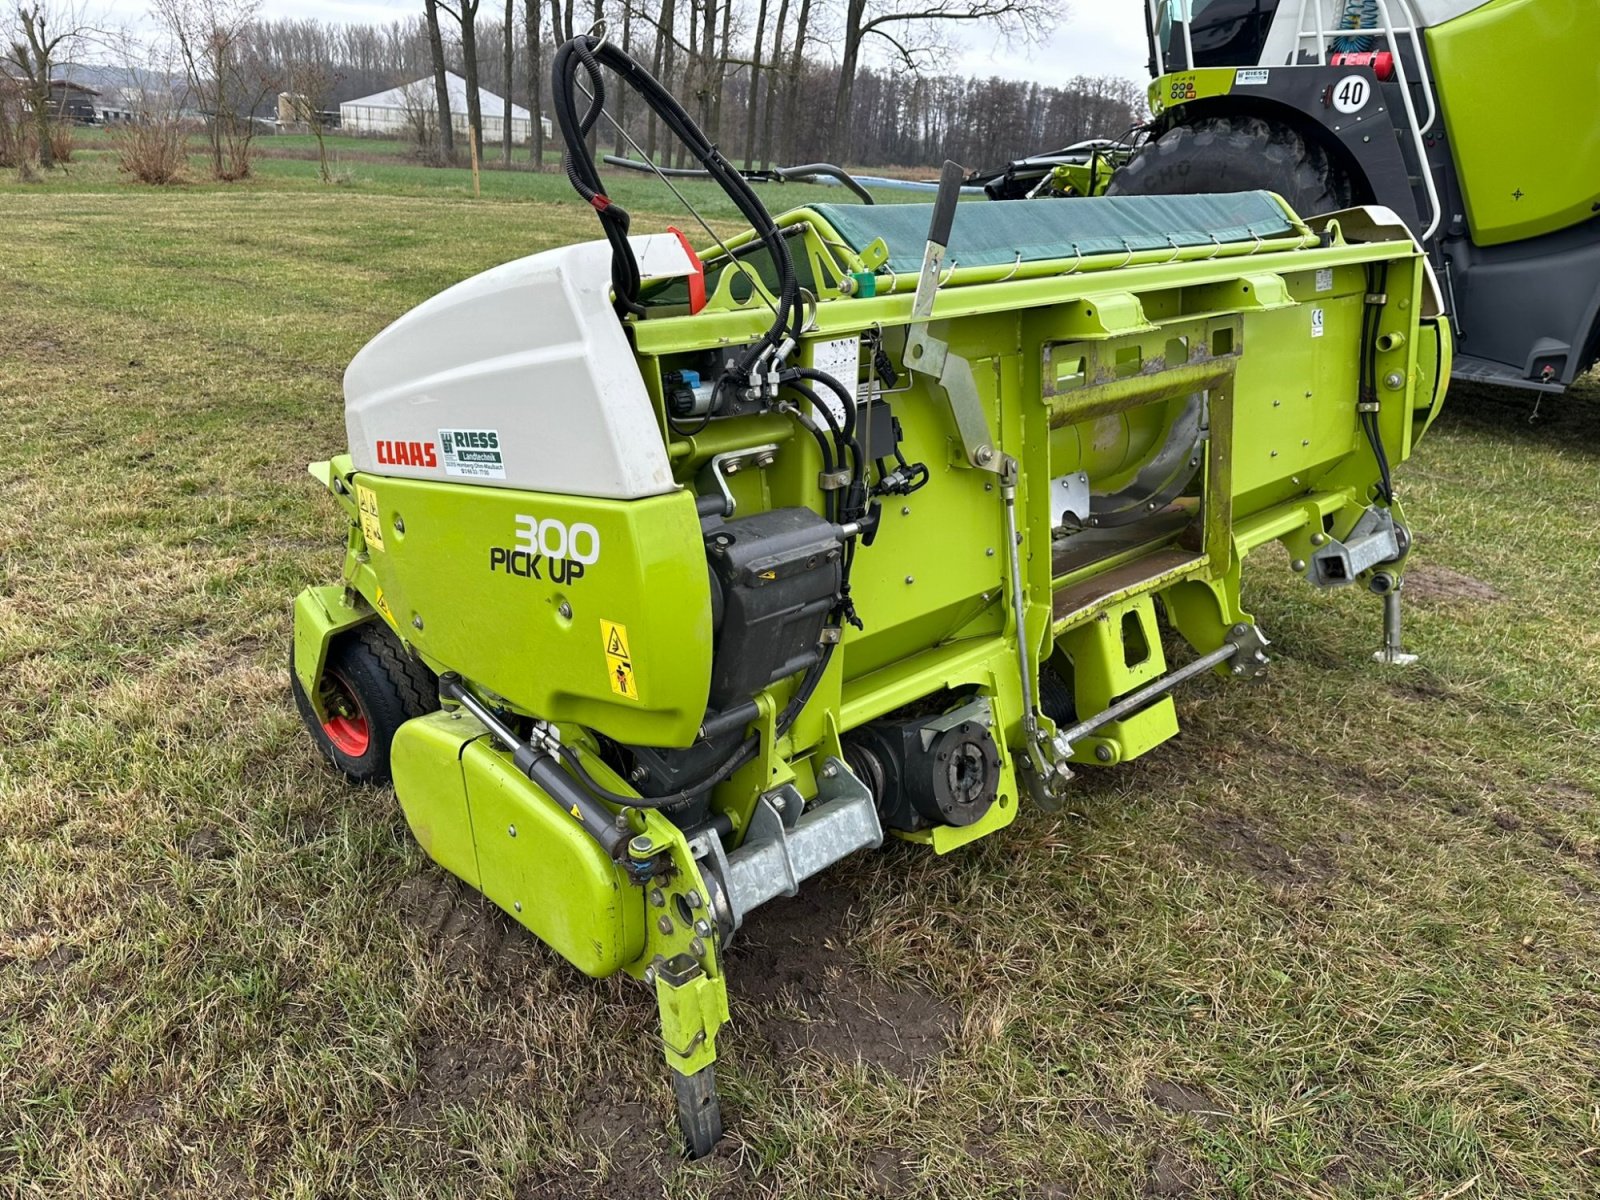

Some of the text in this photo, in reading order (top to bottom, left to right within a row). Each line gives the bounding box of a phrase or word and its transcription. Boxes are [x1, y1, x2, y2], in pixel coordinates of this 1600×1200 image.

[1338, 82, 1363, 105] 40
[1312, 310, 1322, 325] CE
[453, 431, 499, 449] RIESS
[376, 440, 437, 468] CLAAS
[462, 451, 497, 461] Landtechnik
[515, 513, 600, 565] 300
[490, 547, 585, 586] PICK UP
